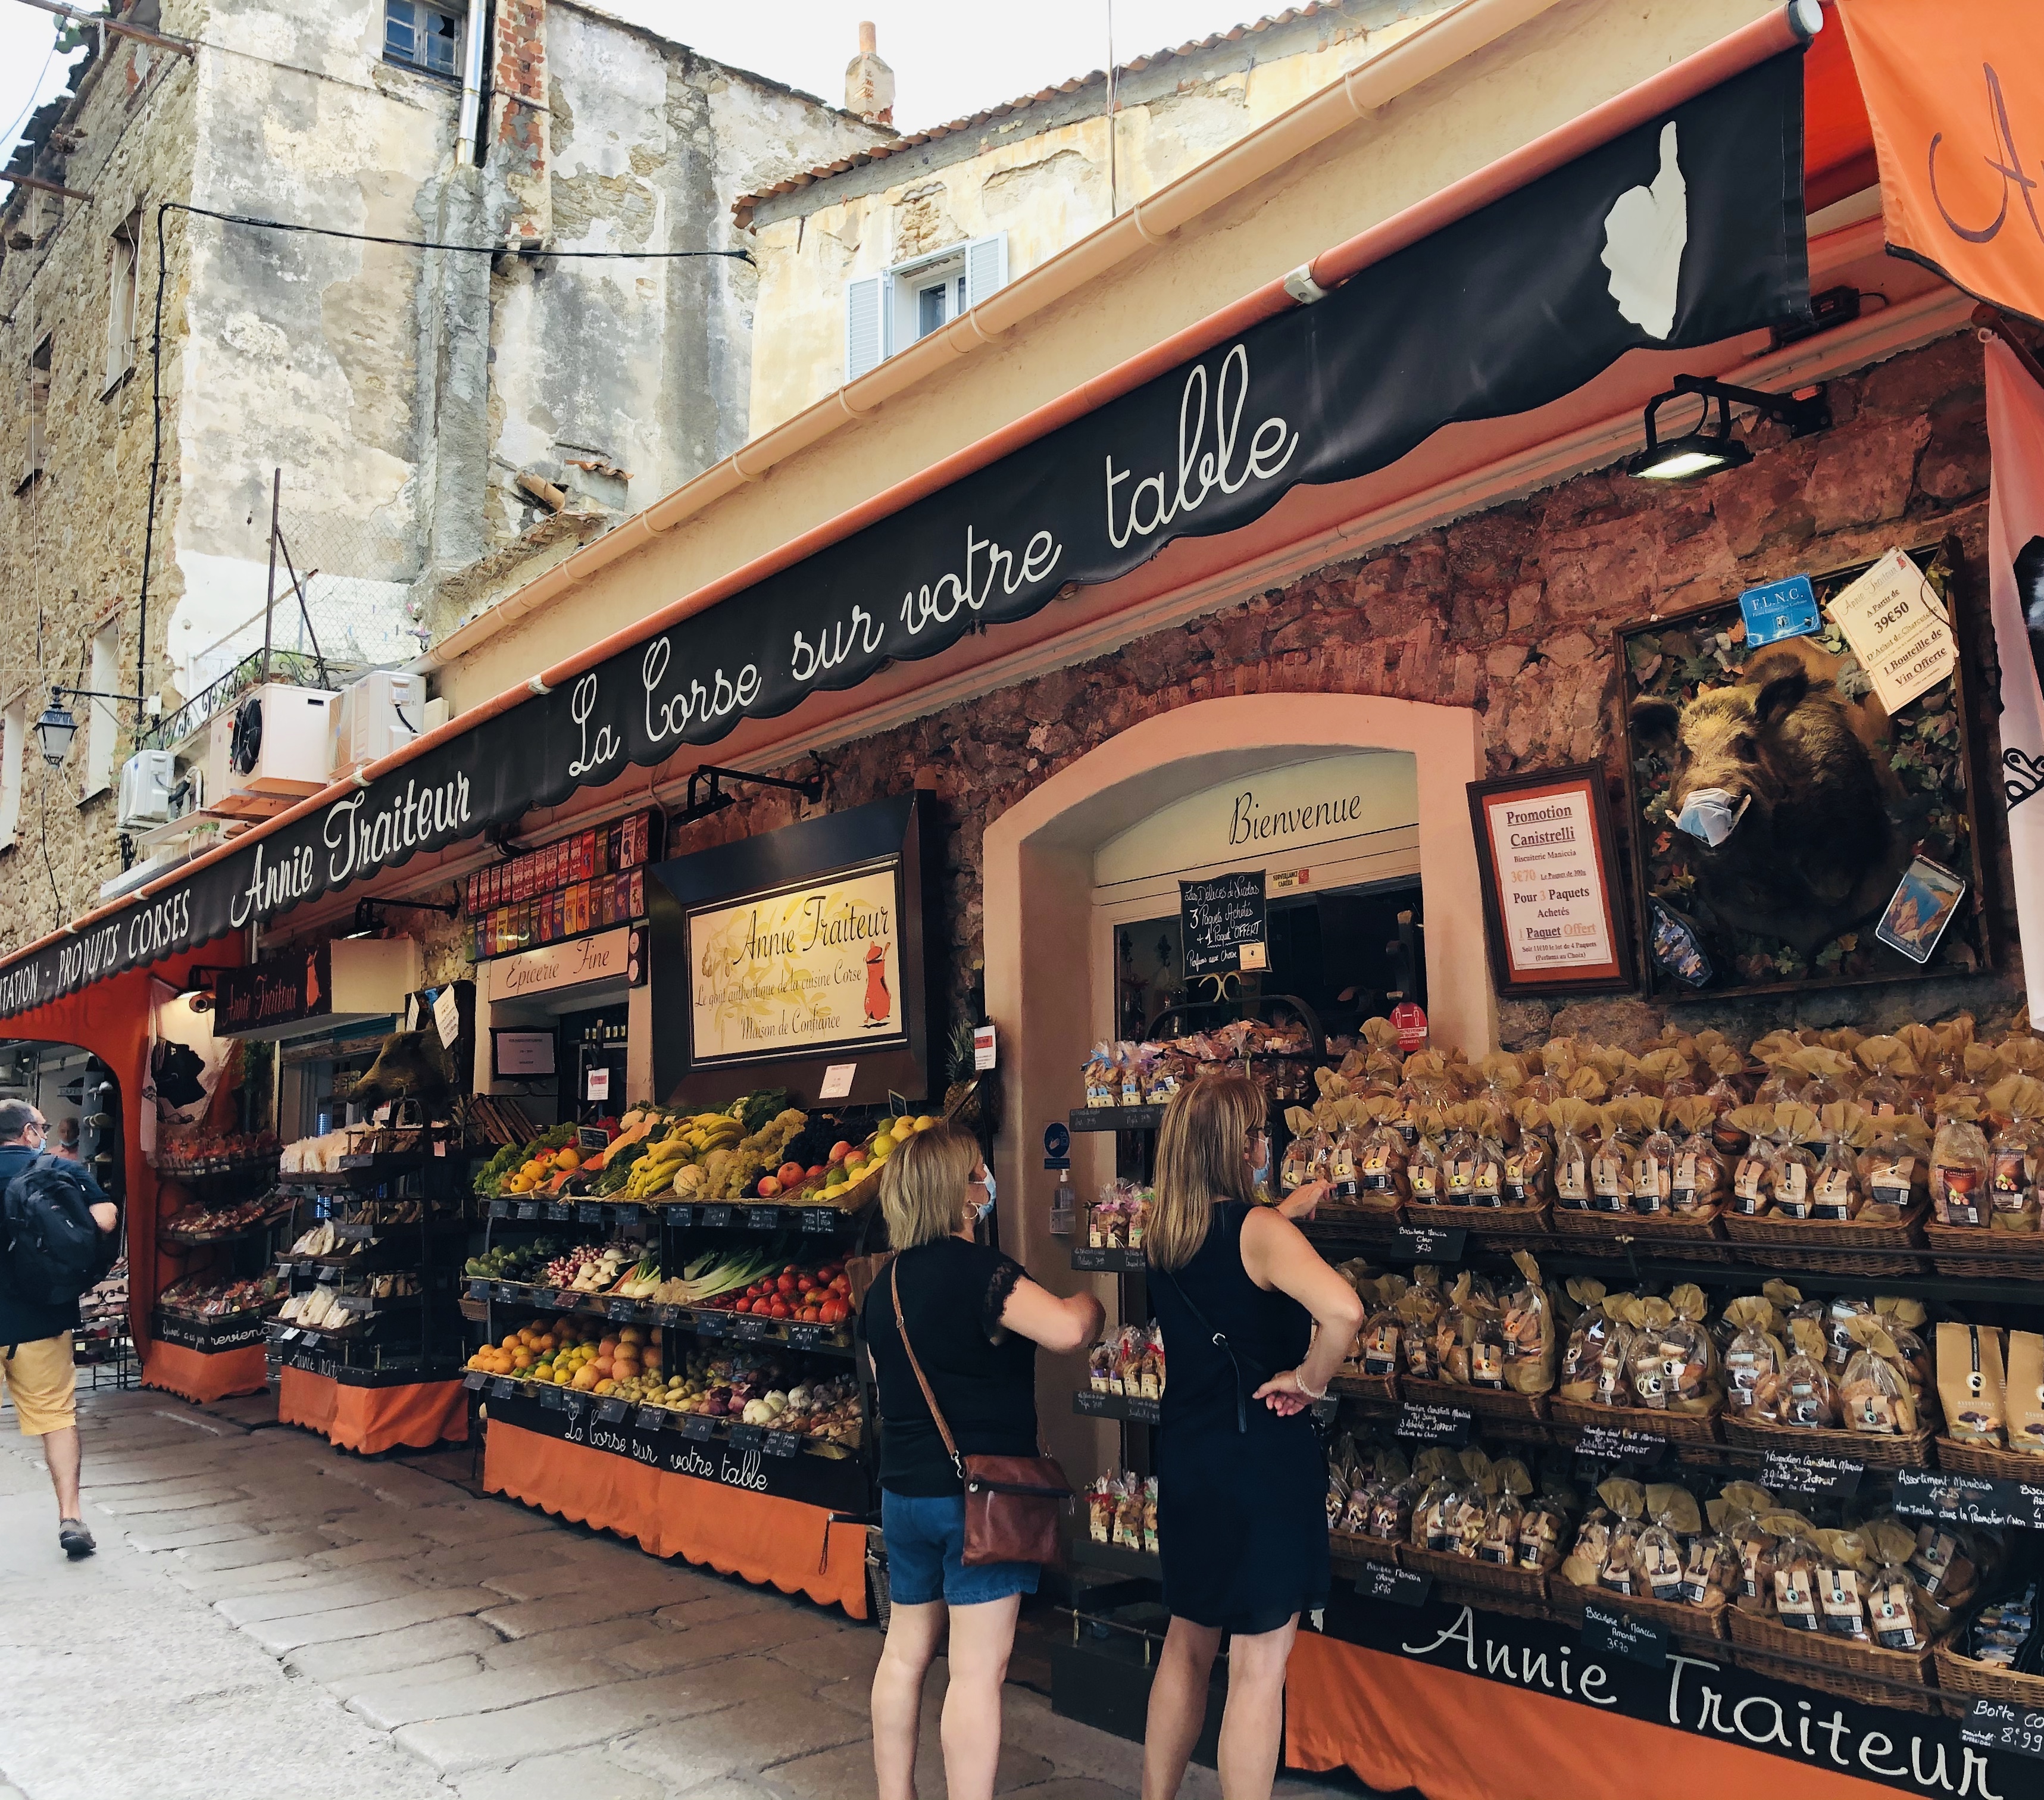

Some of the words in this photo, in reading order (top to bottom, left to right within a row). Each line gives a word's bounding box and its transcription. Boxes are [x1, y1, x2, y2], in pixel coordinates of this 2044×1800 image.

[569, 673, 621, 776] La
[643, 637, 762, 742] Corse
[792, 605, 885, 680] sur
[900, 525, 1062, 635] votre
[1106, 343, 1299, 549] table
[1867, 610, 1873, 618] A
[1872, 596, 1890, 614] Partir
[1891, 588, 1900, 598] de
[1874, 601, 1909, 634] 39€50
[1884, 666, 1889, 675] 1
[1890, 638, 1930, 670] Bouteille
[1931, 629, 1942, 640] de
[1895, 671, 1913, 685] Vin
[1913, 648, 1946, 673] Offerte
[1229, 792, 1362, 845] Bienvenue
[1506, 805, 1572, 825] Promotion
[230, 844, 313, 927] Annie
[324, 771, 471, 882] Traiteur
[1510, 826, 1576, 846] Canistrelli
[1514, 854, 1546, 863] Biscuiterie
[1548, 849, 1577, 859] Maniccia
[1511, 869, 1536, 883] 3€70
[1514, 893, 1537, 904] Pour
[1540, 890, 1546, 901] 3
[1549, 887, 1590, 902] Paquets
[1537, 907, 1570, 918] Achetés
[733, 909, 796, 965] Annie
[802, 895, 890, 952] Traiteur
[1189, 908, 1199, 929] 3
[1199, 904, 1223, 933] Paquets
[1225, 900, 1254, 929] Achetés
[1234, 920, 1262, 939] OFFERT
[1526, 926, 1561, 940] Paquet
[1564, 923, 1596, 935] Offert
[0, 962, 38, 1011] TATION
[129, 889, 190, 960] CORSES
[506, 955, 560, 994] Epicerie
[573, 938, 610, 974] Fine
[694, 984, 707, 1007] Le
[728, 978, 775, 1000] authentique
[777, 969, 787, 993] de
[790, 967, 799, 992] la
[801, 970, 831, 990] cuisine
[833, 958, 862, 985] Corse
[740, 1013, 776, 1040] Maison
[778, 1009, 789, 1035] de
[792, 1004, 841, 1039] Confiance
[565, 1409, 583, 1442] La
[590, 1409, 627, 1452] Corse
[633, 1439, 658, 1463] sur
[670, 1445, 714, 1477] votre
[721, 1449, 768, 1491] table
[1402, 1606, 1617, 1705] Annie
[1665, 1653, 2004, 1800] Traiteur
